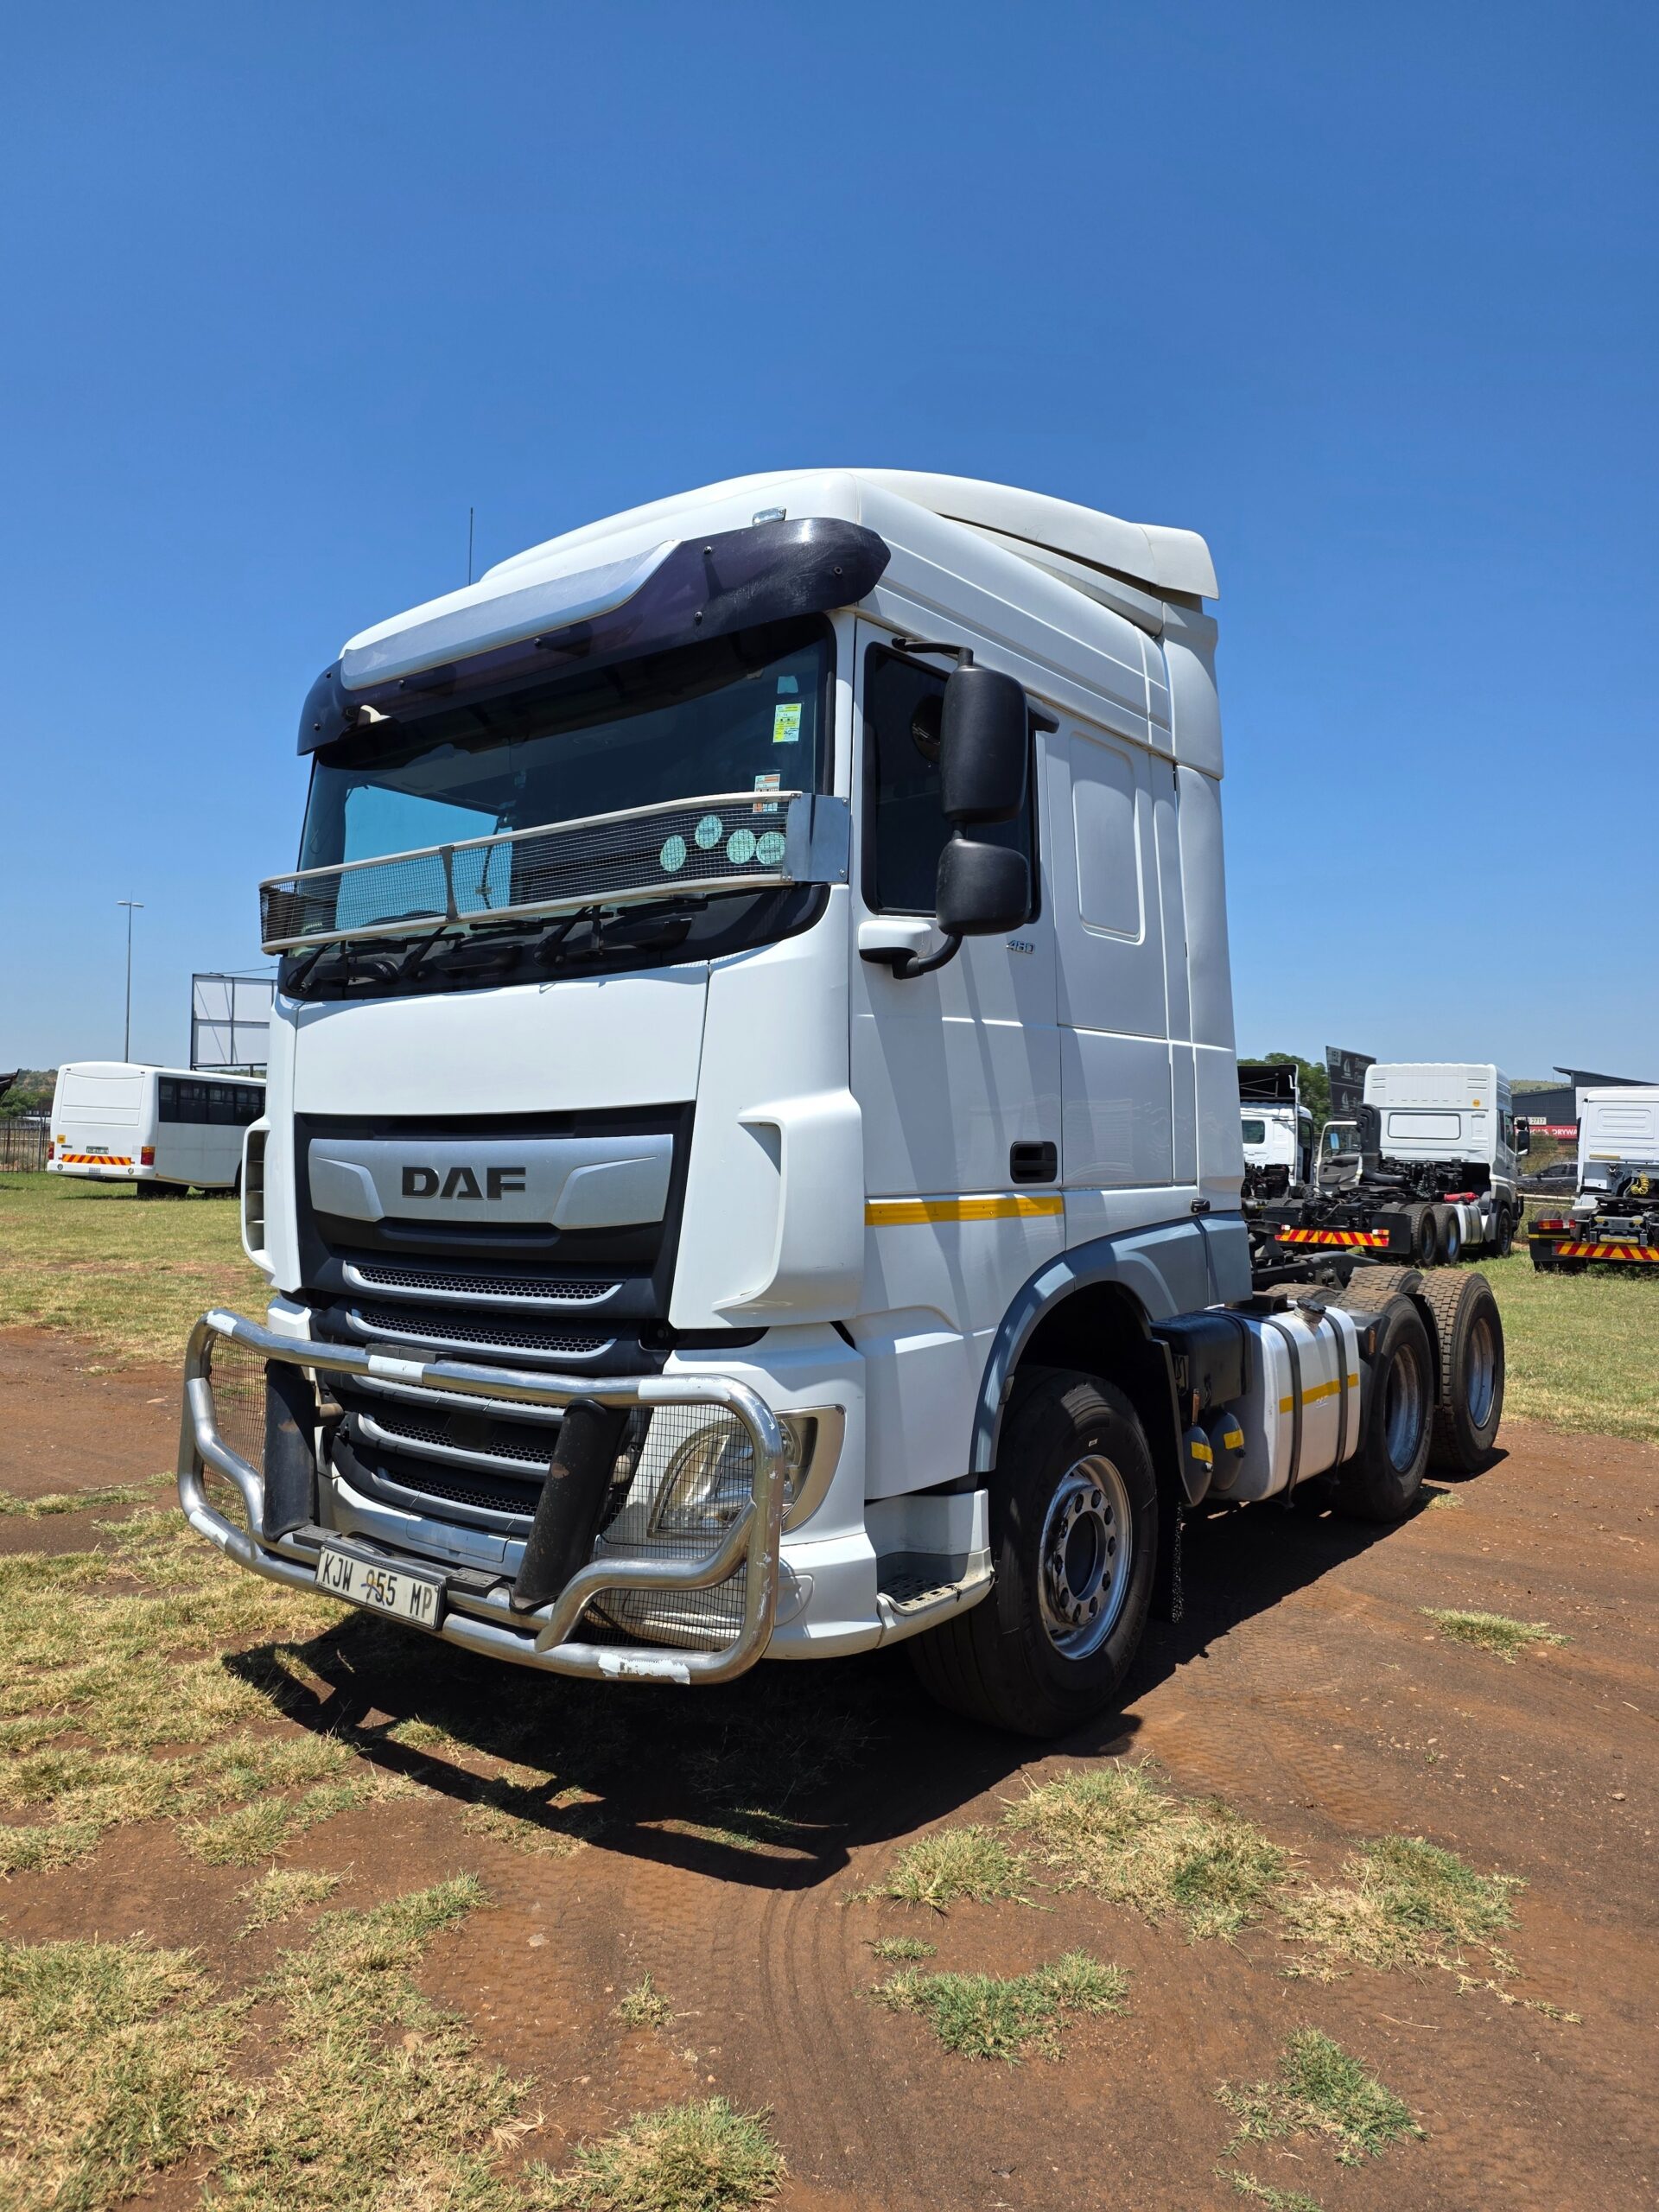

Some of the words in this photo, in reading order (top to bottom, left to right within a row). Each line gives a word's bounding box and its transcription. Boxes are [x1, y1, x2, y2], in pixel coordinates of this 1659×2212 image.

[1006, 939, 1036, 954] 480
[402, 1166, 526, 1200] DAF
[322, 1553, 353, 1592] KJW
[410, 1582, 432, 1618] MP
